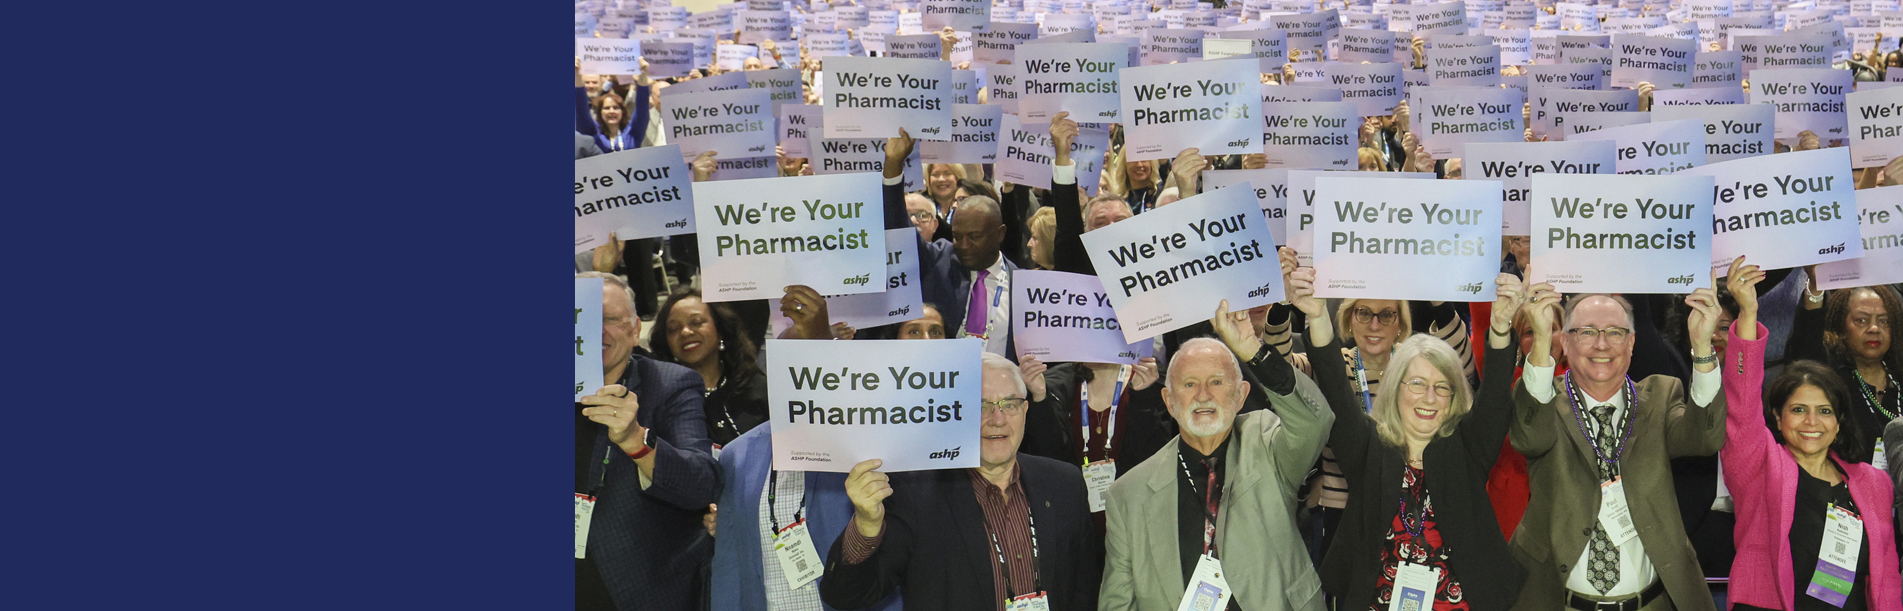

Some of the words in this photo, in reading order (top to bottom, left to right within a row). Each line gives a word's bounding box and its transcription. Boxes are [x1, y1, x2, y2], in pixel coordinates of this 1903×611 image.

[926, 5, 985, 16] Pharmacist
[1416, 13, 1440, 22] We're
[1441, 10, 1460, 18] Your
[1276, 21, 1300, 30] We're
[1302, 20, 1321, 28] Your
[1416, 18, 1463, 32] Pharmacist
[1008, 32, 1032, 40] Your
[1152, 35, 1177, 43] We're
[1286, 30, 1323, 38] armacist
[1345, 35, 1368, 44] We're
[1371, 37, 1390, 45] Your
[1511, 36, 1526, 44] Your
[1676, 29, 1694, 37] Your
[613, 45, 634, 53] Your
[890, 42, 915, 50] We're
[917, 41, 937, 49] Your
[1258, 38, 1280, 46] Your
[1764, 44, 1797, 54] We're
[1800, 44, 1825, 53] Your
[643, 48, 668, 56] We're
[670, 48, 689, 56] Your
[890, 50, 939, 58] Pharmacist
[1152, 45, 1199, 54] Pharmacist
[1343, 45, 1390, 54] Pharmacist
[1622, 44, 1656, 56] We're
[1660, 47, 1687, 58] Your
[583, 54, 635, 62] Pharmacist
[1436, 57, 1467, 67] We're
[1470, 56, 1494, 65] Your
[1620, 58, 1687, 72] Pharmacist
[1710, 60, 1734, 70] Your
[1764, 56, 1826, 66] Pharmacist
[1025, 59, 1071, 74] We're
[1076, 58, 1116, 73] Your
[1435, 66, 1495, 80] Pharmacist
[768, 79, 794, 88] Your
[836, 72, 892, 88] We're
[897, 74, 940, 90] Your
[1332, 74, 1366, 84] We're
[1368, 74, 1395, 83] Your
[1536, 74, 1568, 82] We're
[1570, 73, 1594, 82] Your
[1025, 78, 1118, 94] Pharmacist
[1134, 82, 1192, 102] We're
[1196, 80, 1246, 96] Your
[1762, 82, 1807, 96] We're
[1810, 82, 1844, 95] Your
[836, 92, 942, 110] Pharmacist
[1556, 102, 1596, 112] We're
[1599, 102, 1630, 112] Your
[672, 106, 719, 120] We're
[722, 104, 760, 116] Your
[1098, 110, 1118, 118] ashp
[1134, 101, 1250, 126] Pharmacist
[1431, 104, 1474, 117] We're
[1478, 102, 1512, 114] Your
[1860, 103, 1903, 120] We'r
[673, 119, 764, 138] Pharmacist
[962, 116, 993, 127] Your
[1265, 115, 1308, 128] We're
[1312, 115, 1347, 128] Your
[1431, 118, 1515, 134] Pharmacist
[1721, 120, 1762, 134] Your
[922, 127, 940, 136] ashp
[1228, 138, 1250, 148] ashp
[1263, 132, 1349, 146] Pharmacist
[822, 141, 868, 154] We're
[1642, 140, 1690, 157] Your
[1705, 140, 1763, 154] macist
[1481, 161, 1545, 178] We're
[1550, 160, 1600, 174] Your
[575, 176, 614, 194] e're
[616, 166, 670, 183] Your
[1713, 181, 1768, 206] e're
[1773, 174, 1834, 196] Your
[714, 201, 796, 226] We're
[802, 200, 864, 221] Your
[1334, 201, 1414, 224] We're
[1420, 202, 1483, 226] Your
[1550, 197, 1628, 219] We're
[1636, 198, 1695, 220] Your
[665, 218, 687, 229] ashp
[1712, 200, 1842, 235] harmacist
[716, 228, 869, 257] Pharmacist
[1108, 232, 1186, 268] We're
[1188, 212, 1247, 242] Your
[1330, 231, 1485, 256] Pharmacist
[1548, 227, 1696, 250] Pharmacist
[1818, 242, 1846, 254] ashp
[1119, 239, 1264, 298] Pharmacist
[843, 272, 870, 286] ashp
[1668, 273, 1695, 286] ashp
[1248, 282, 1270, 299] ashp
[1455, 281, 1484, 294] ashp
[1026, 288, 1088, 306] We're
[888, 304, 910, 316] ashp
[1024, 311, 1120, 330] Pharmac
[788, 366, 880, 391] We're
[888, 366, 960, 390] Your
[788, 398, 963, 425] Pharmacist
[929, 446, 962, 460] ashp
[1838, 522, 1849, 531] Nish
[1828, 554, 1847, 564] ATTENDEE
